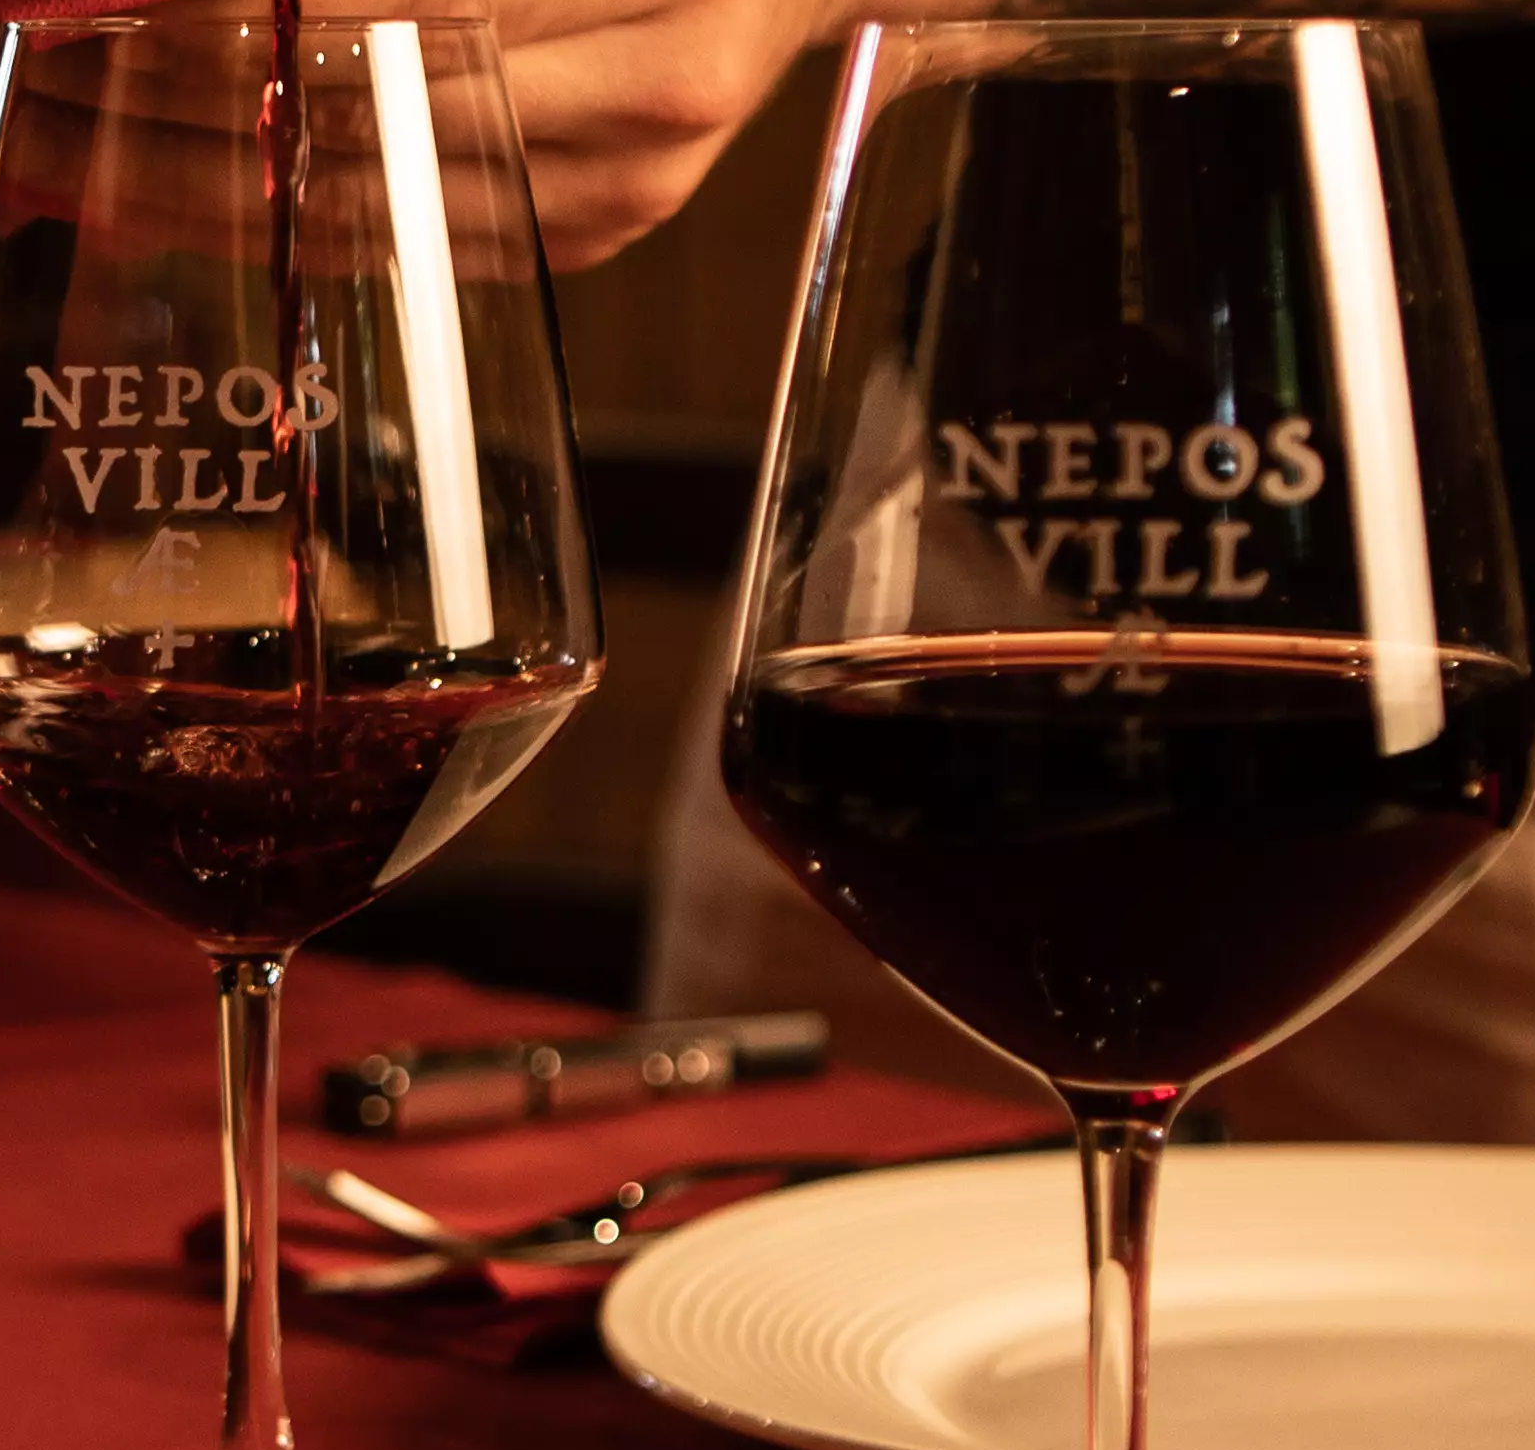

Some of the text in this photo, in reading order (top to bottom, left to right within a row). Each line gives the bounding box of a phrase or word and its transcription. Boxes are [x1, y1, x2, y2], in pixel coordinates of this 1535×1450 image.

[22, 362, 340, 432] NEPOS
[62, 445, 287, 514] VILL
[938, 416, 1325, 506] NEPOS
[993, 518, 1270, 599] VILL
